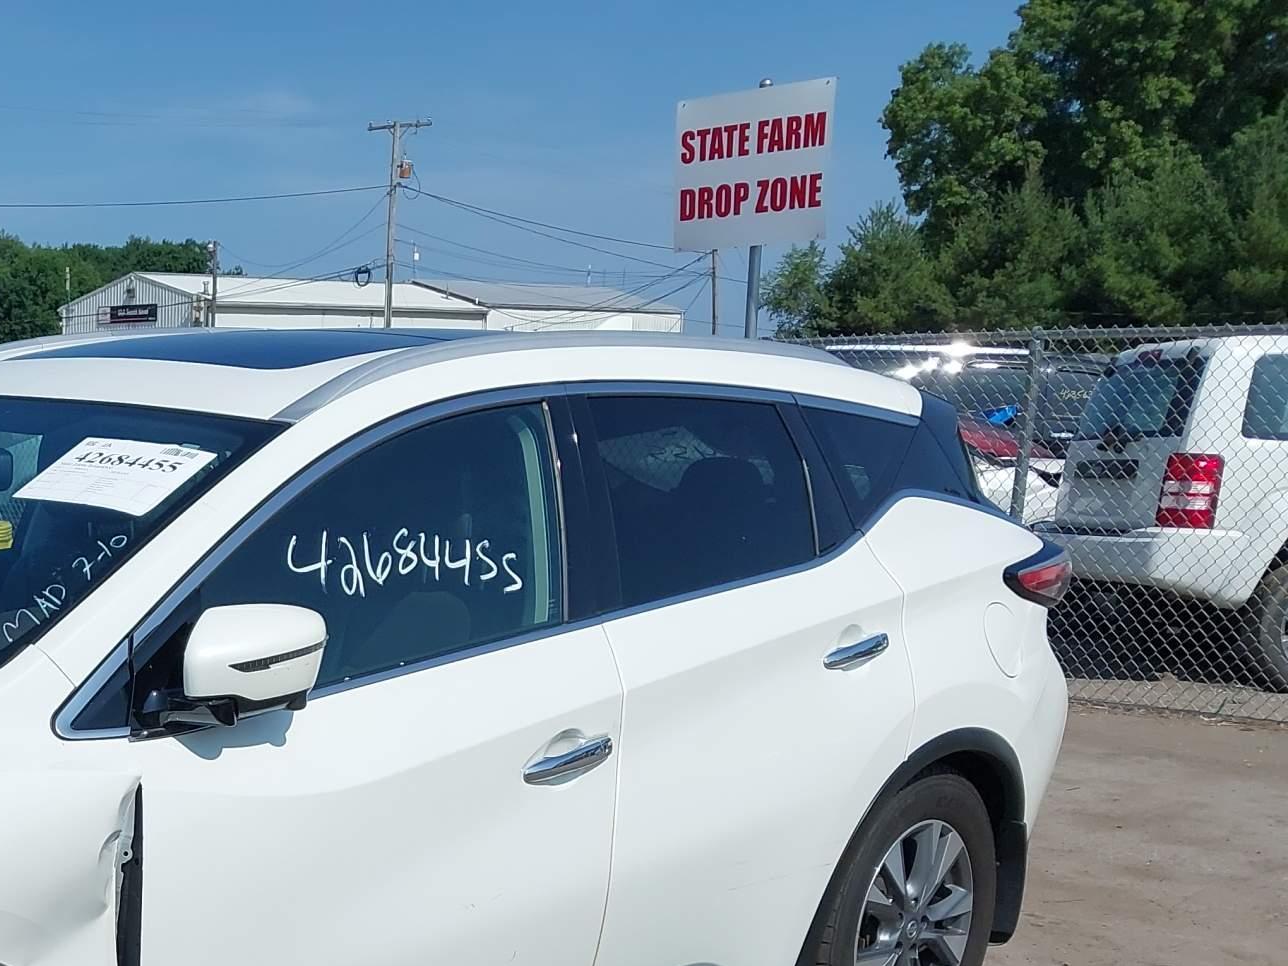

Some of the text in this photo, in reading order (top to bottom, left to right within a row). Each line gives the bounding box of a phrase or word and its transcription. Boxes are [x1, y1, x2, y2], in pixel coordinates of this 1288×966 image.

[681, 111, 827, 165] STATE FARM
[679, 172, 823, 222] DROP ZONE
[74, 451, 185, 473] 42684455
